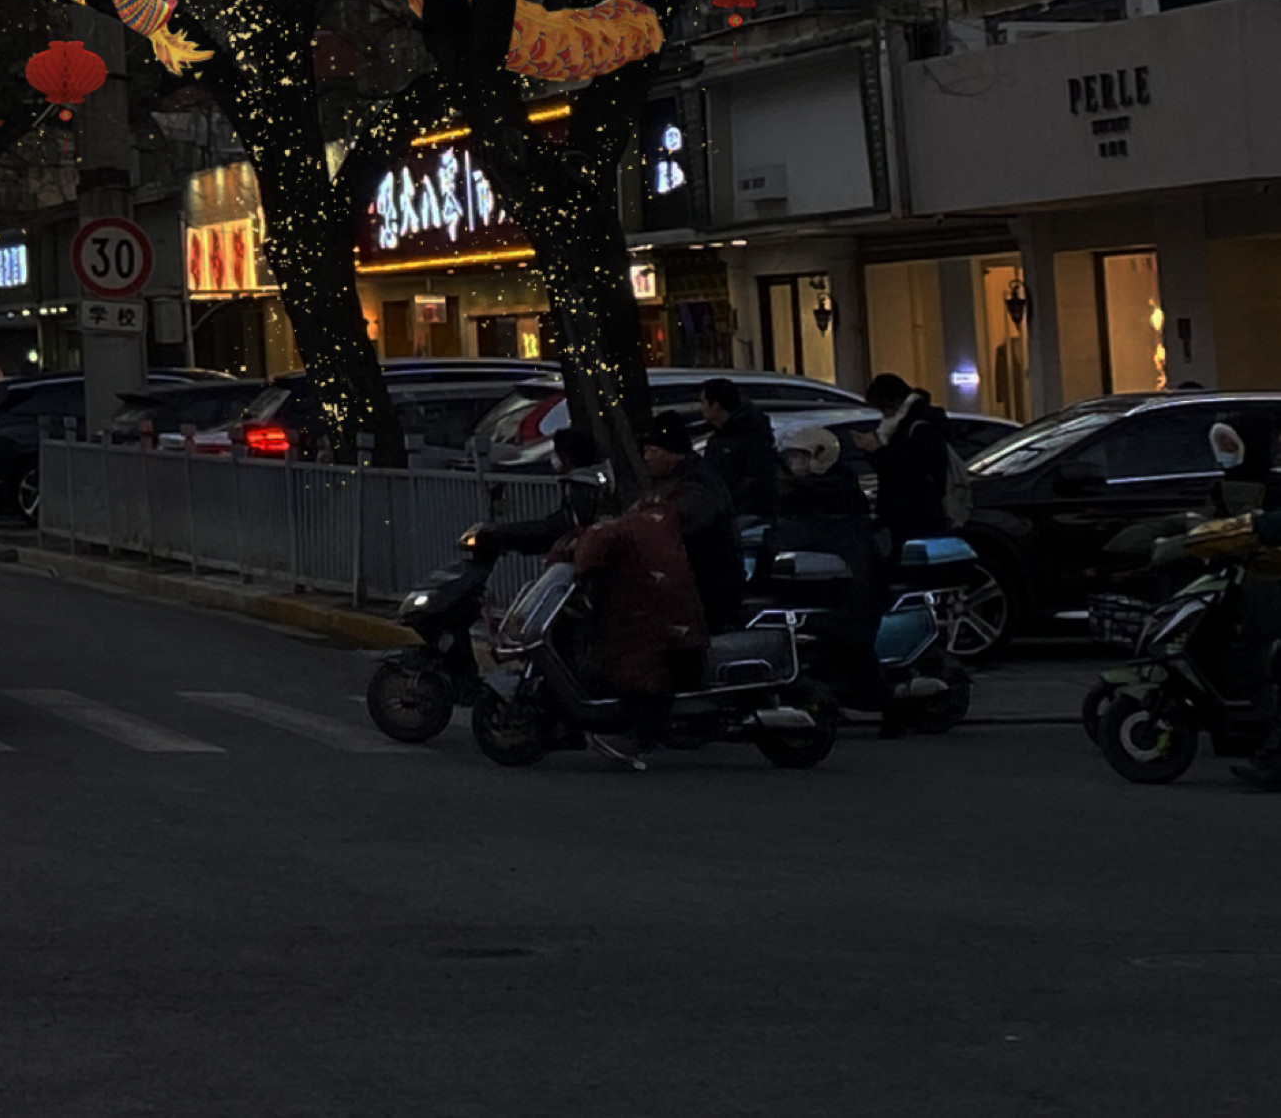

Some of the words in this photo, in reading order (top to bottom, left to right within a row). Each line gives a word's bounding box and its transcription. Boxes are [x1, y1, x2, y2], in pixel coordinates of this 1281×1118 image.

[1068, 66, 1150, 116] PERLE
[91, 237, 135, 278] 30
[89, 306, 136, 327] 学校
